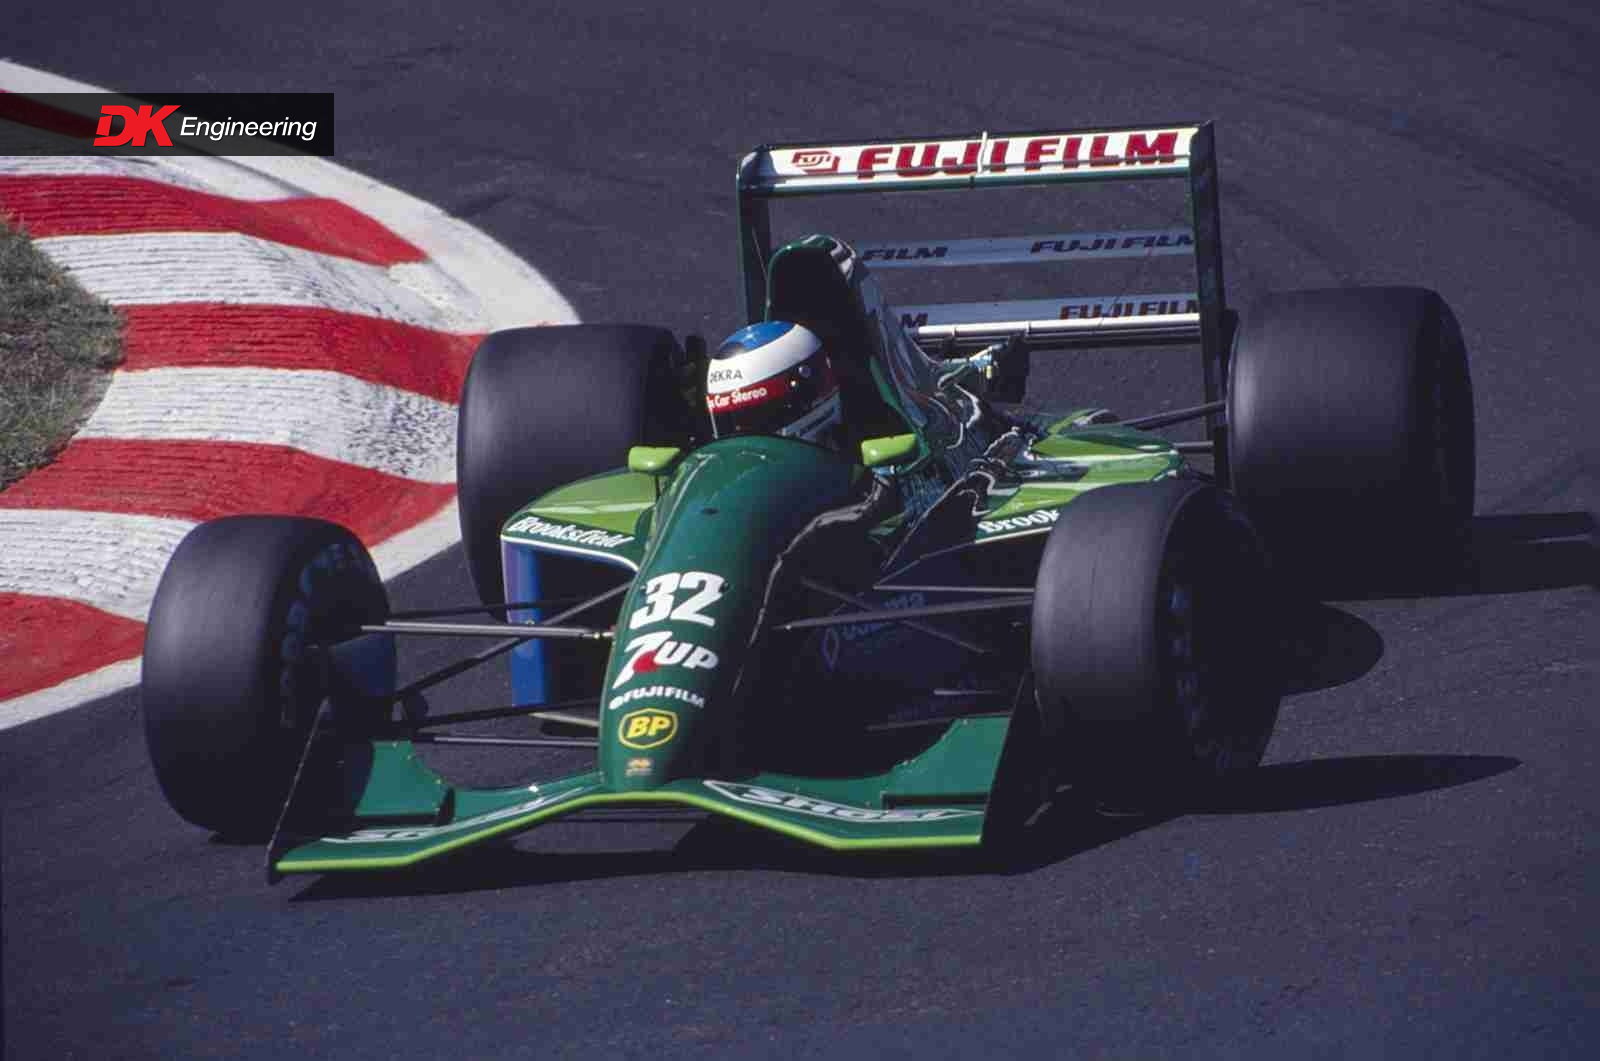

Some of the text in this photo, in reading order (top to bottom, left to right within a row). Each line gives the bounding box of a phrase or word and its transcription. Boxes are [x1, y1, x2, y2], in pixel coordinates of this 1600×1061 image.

[730, 387, 768, 405] Stereo
[629, 570, 725, 630] 32
[627, 716, 672, 739] BP
